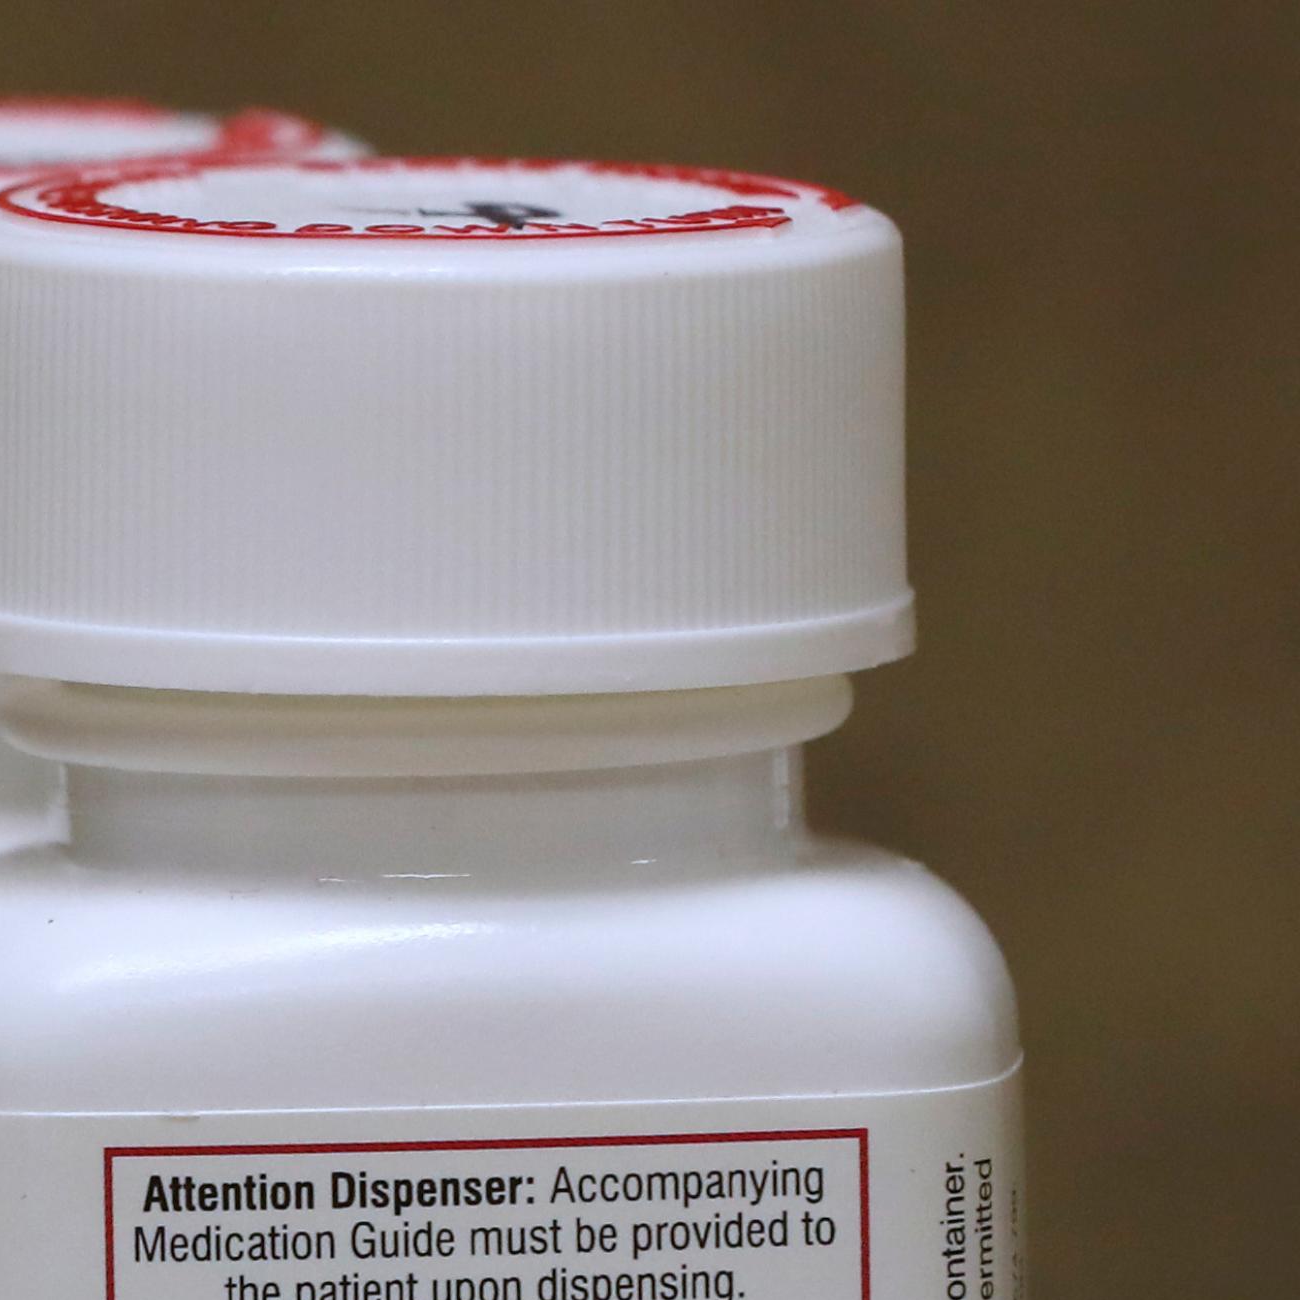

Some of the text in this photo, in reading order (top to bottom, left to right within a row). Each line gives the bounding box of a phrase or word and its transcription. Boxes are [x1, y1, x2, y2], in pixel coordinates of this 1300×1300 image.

[143, 1162, 824, 1215] Attention Dispenser: Accompanying
[134, 1212, 836, 1263] Medication Guide must be provided to
